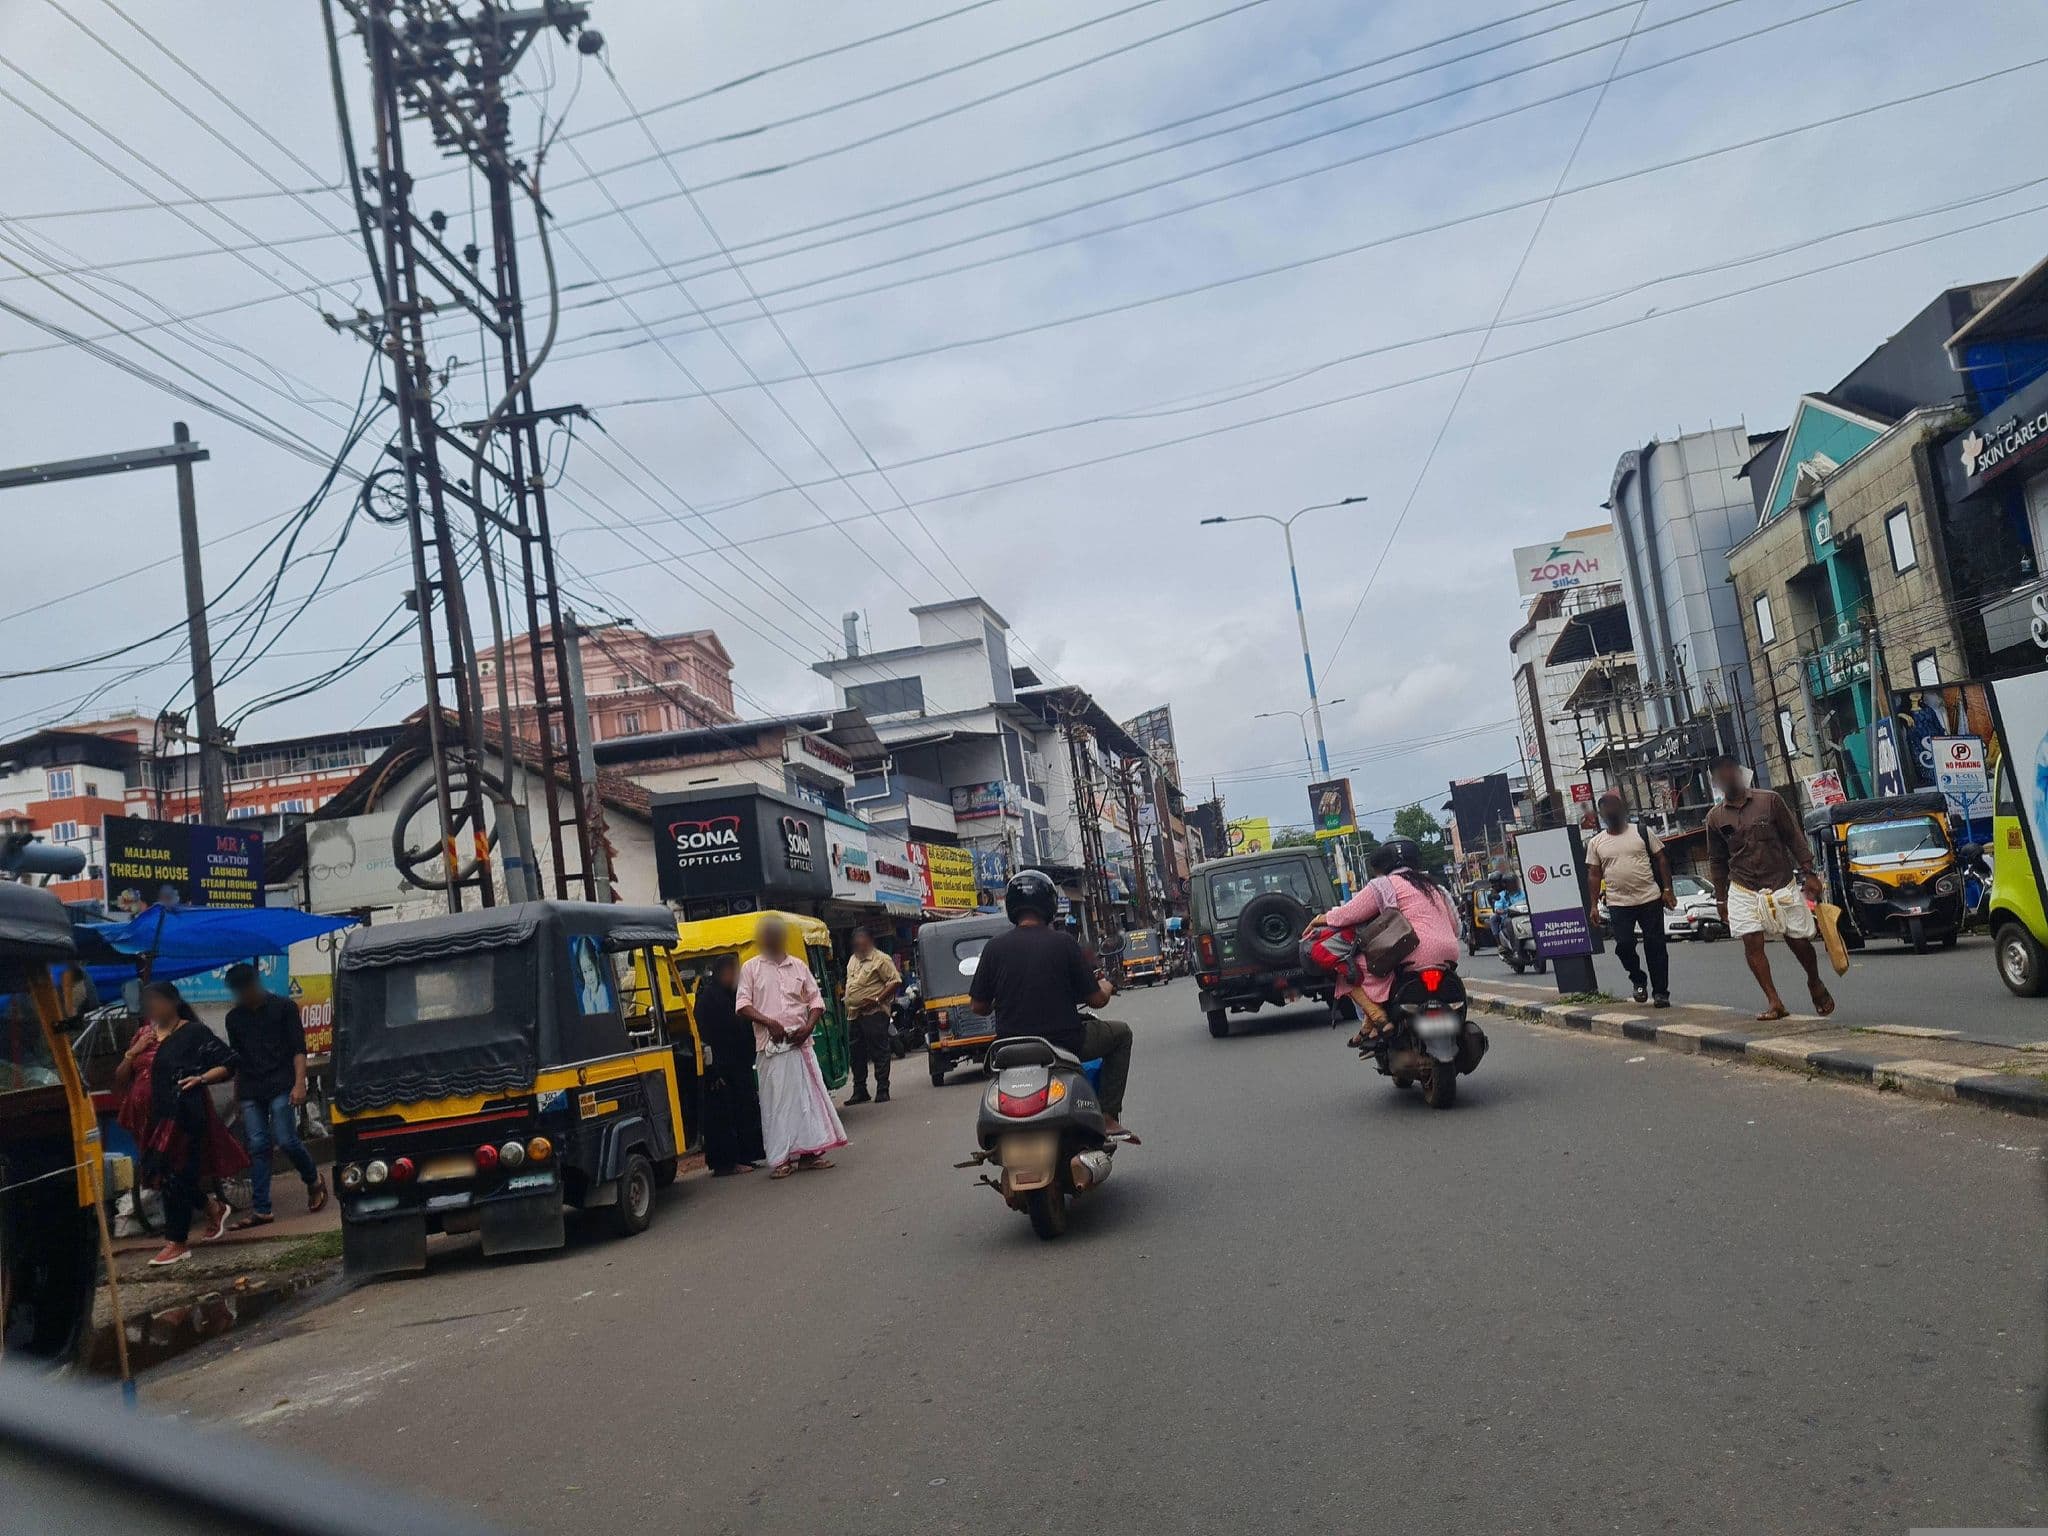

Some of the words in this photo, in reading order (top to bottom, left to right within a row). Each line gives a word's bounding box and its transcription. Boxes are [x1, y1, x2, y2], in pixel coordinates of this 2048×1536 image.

[1978, 442, 2005, 472] SKIN
[2005, 421, 2037, 453] CARE
[1530, 558, 1599, 581] ZORAH
[1955, 761, 1981, 769] PARKING
[677, 829, 738, 850] SONA
[788, 833, 812, 856] SONA
[124, 847, 171, 861] MALABAR
[207, 854, 249, 866] CREATION
[679, 852, 742, 867] OPTICALS
[110, 862, 151, 879] THREAD
[154, 866, 189, 881] HOUSE
[210, 866, 248, 877] LAUNDRY
[789, 858, 814, 873] OPTICALS
[1549, 864, 1572, 879] LG
[201, 878, 226, 889] STEAM
[227, 879, 257, 889] IRONING
[208, 890, 252, 901] TAILORING
[1537, 926, 1586, 938] Electronics
